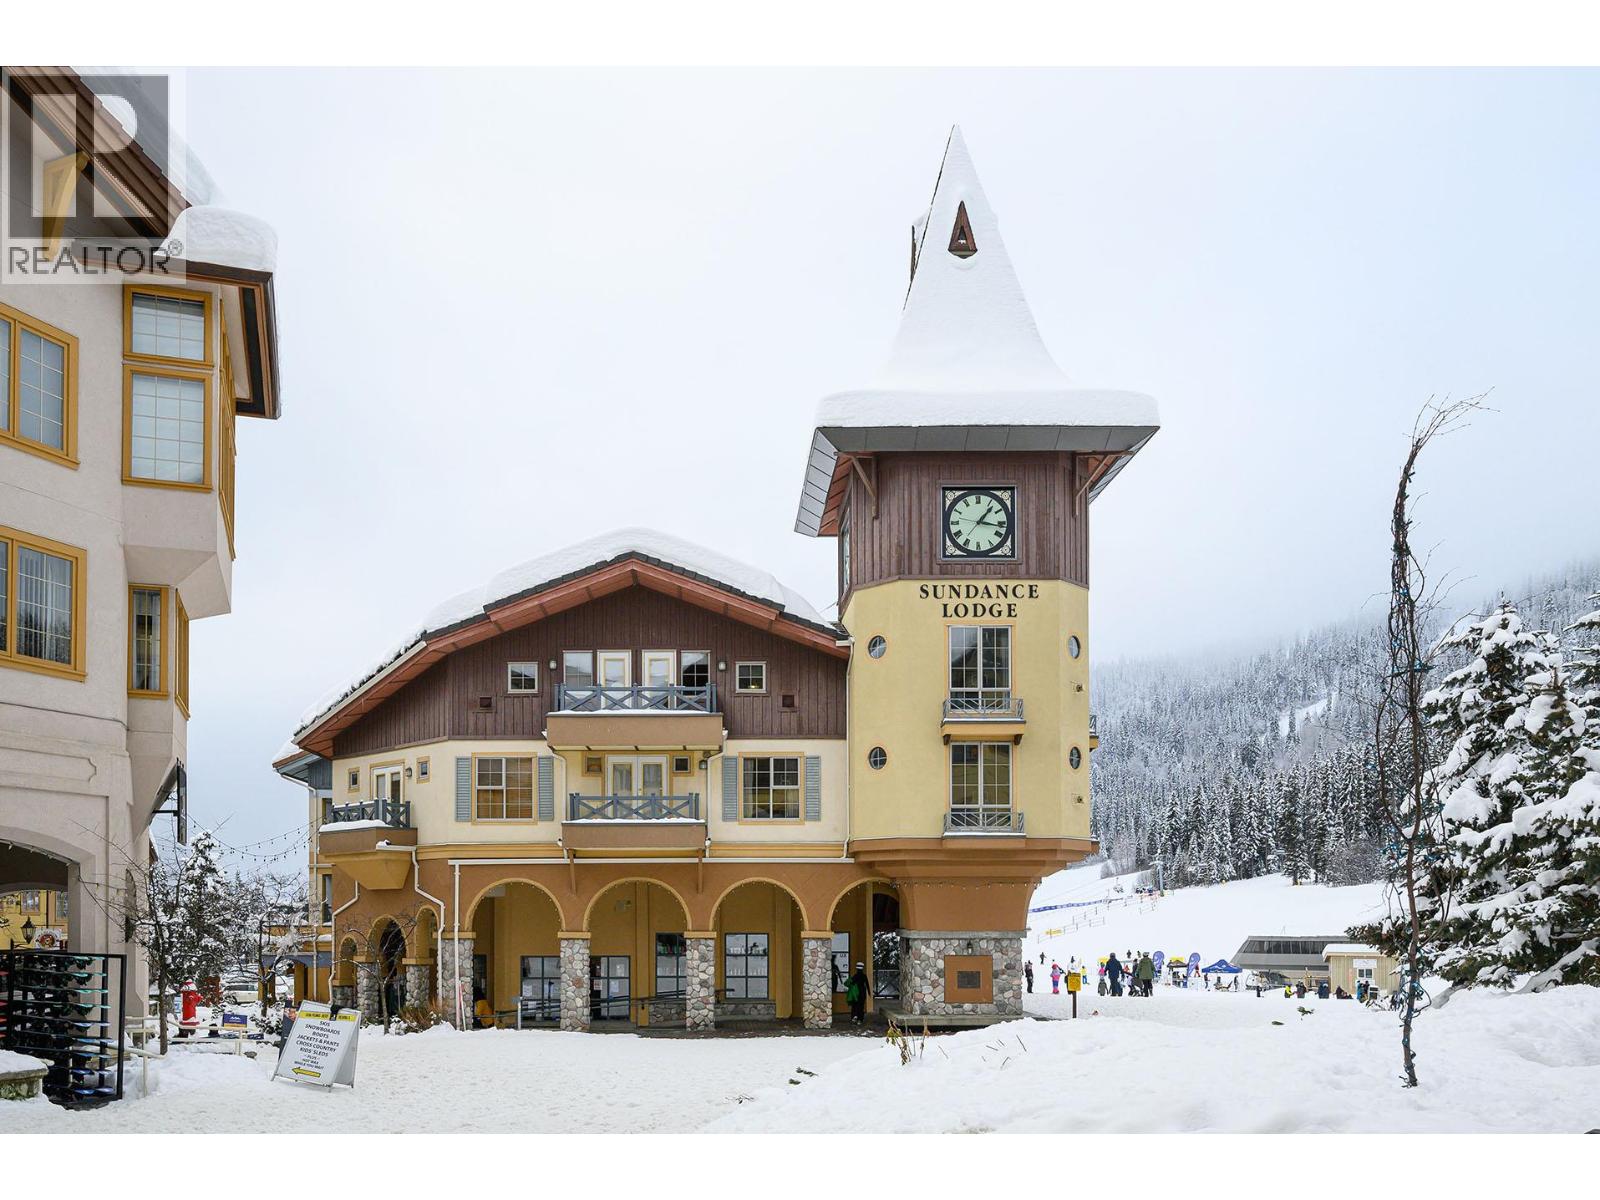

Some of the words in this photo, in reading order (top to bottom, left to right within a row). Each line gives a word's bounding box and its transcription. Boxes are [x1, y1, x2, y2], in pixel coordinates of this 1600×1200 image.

[920, 584, 1039, 599] SUNDANCE
[942, 603, 1018, 618] LODGE
[305, 1024, 341, 1035] SNOWBOARDS
[297, 1034, 318, 1042] JACKETS
[312, 1031, 329, 1039] BOOTS
[313, 1044, 336, 1052] COUNTRY
